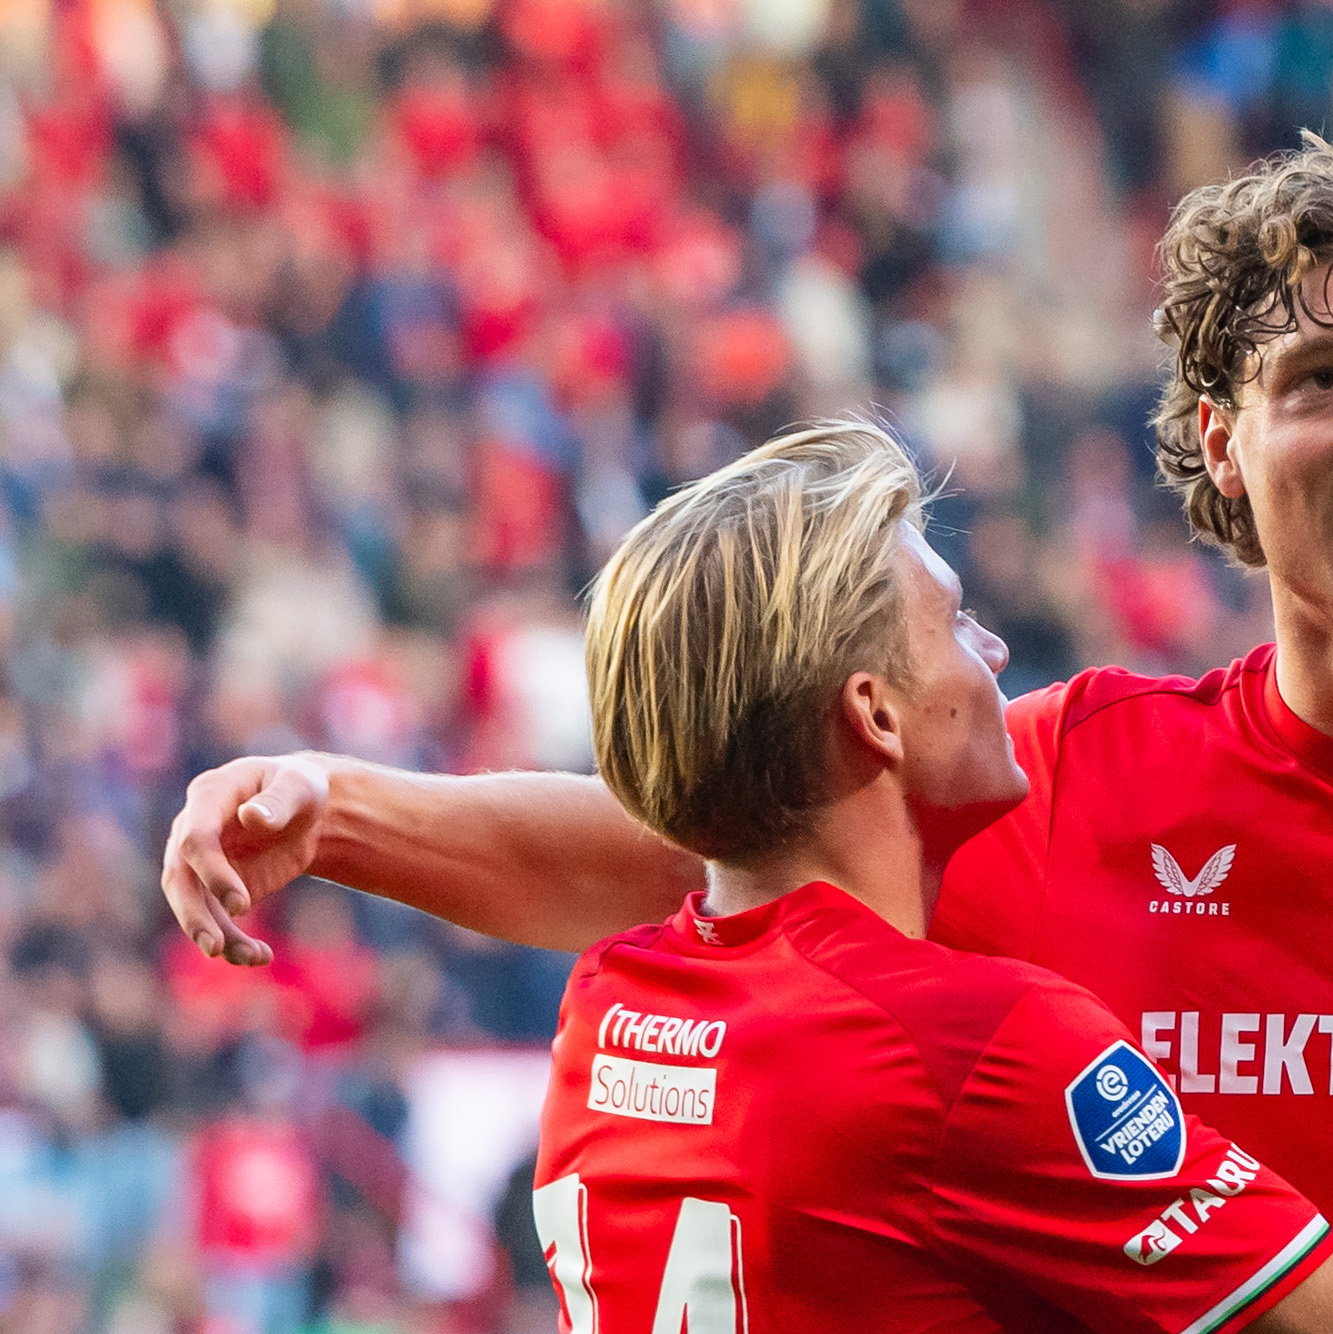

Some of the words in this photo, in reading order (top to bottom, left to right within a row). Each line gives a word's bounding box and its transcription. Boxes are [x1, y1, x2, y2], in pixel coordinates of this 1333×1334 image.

[1149, 901, 1230, 915] CASTORE
[595, 1065, 709, 1118] Solutions
[1100, 1090, 1169, 1154] VRIENDEN
